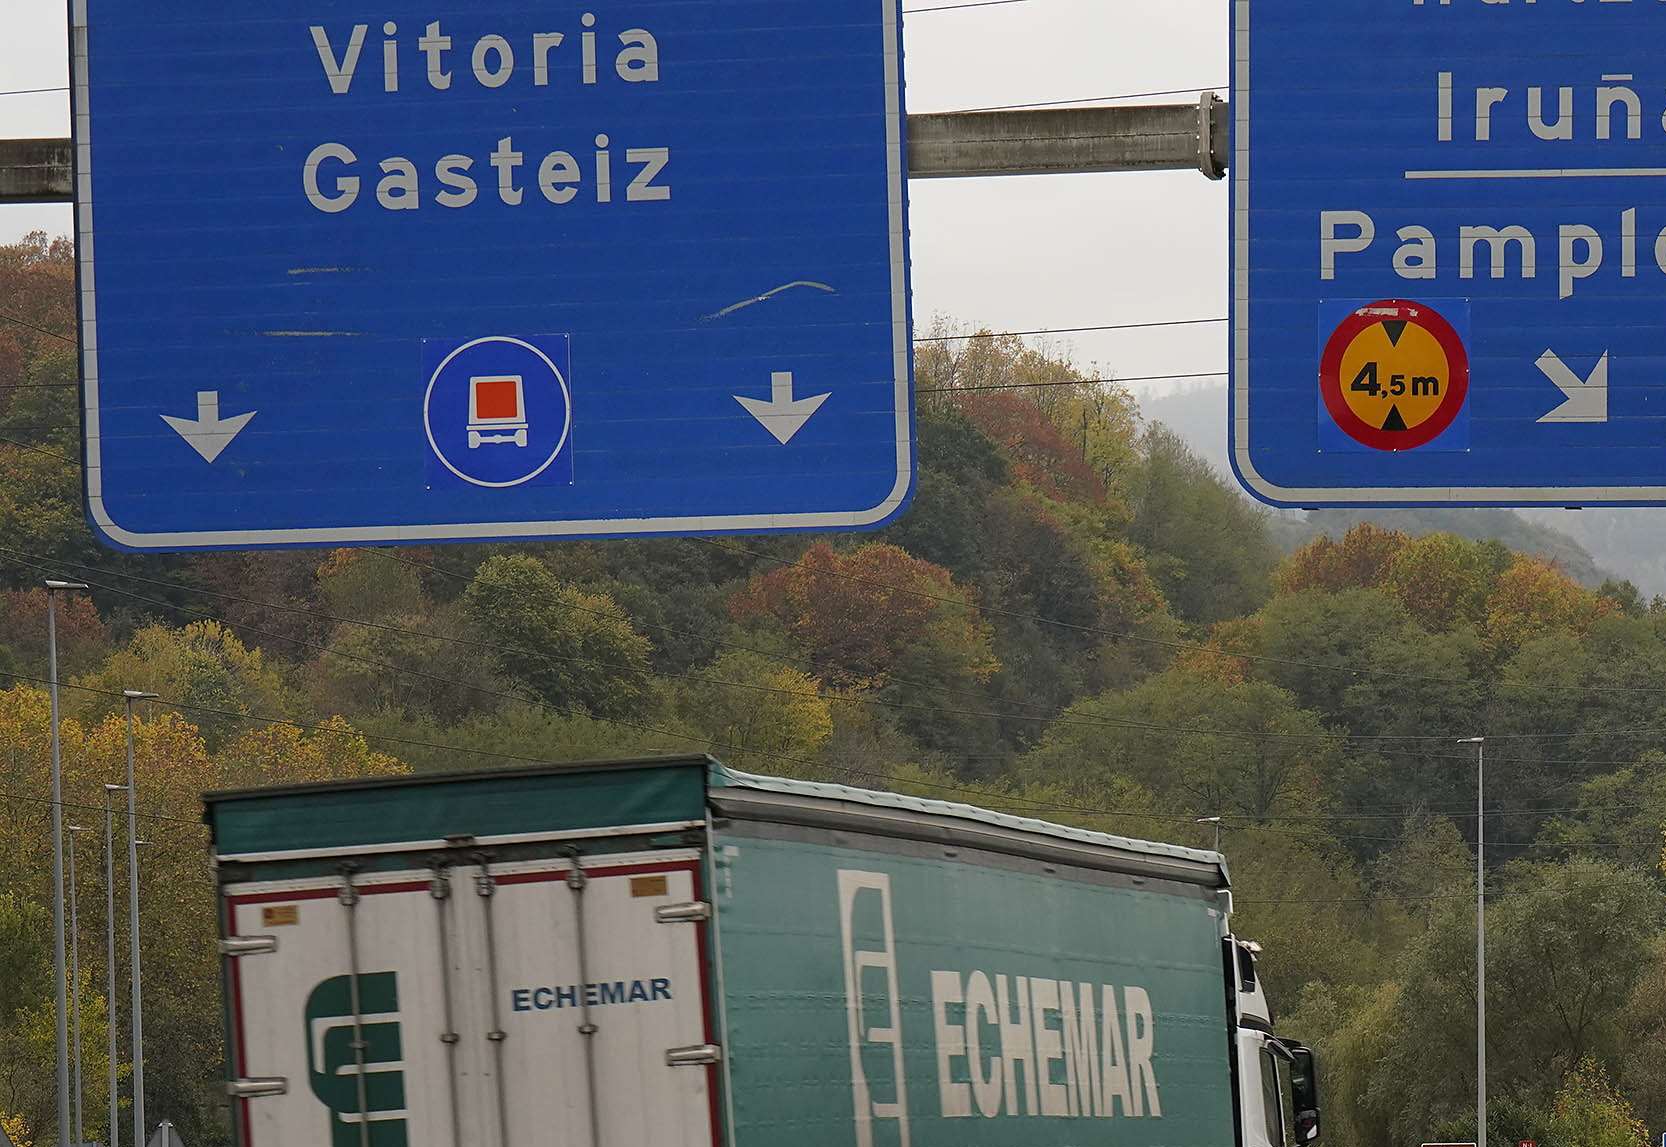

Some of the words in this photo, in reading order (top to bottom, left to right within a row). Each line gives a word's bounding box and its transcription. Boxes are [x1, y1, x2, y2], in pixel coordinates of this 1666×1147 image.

[309, 12, 660, 94] Vitoria
[303, 133, 671, 213] Gasteiz
[511, 977, 673, 1012] ECHEMAR
[929, 969, 1163, 1119] ECHEMAR
